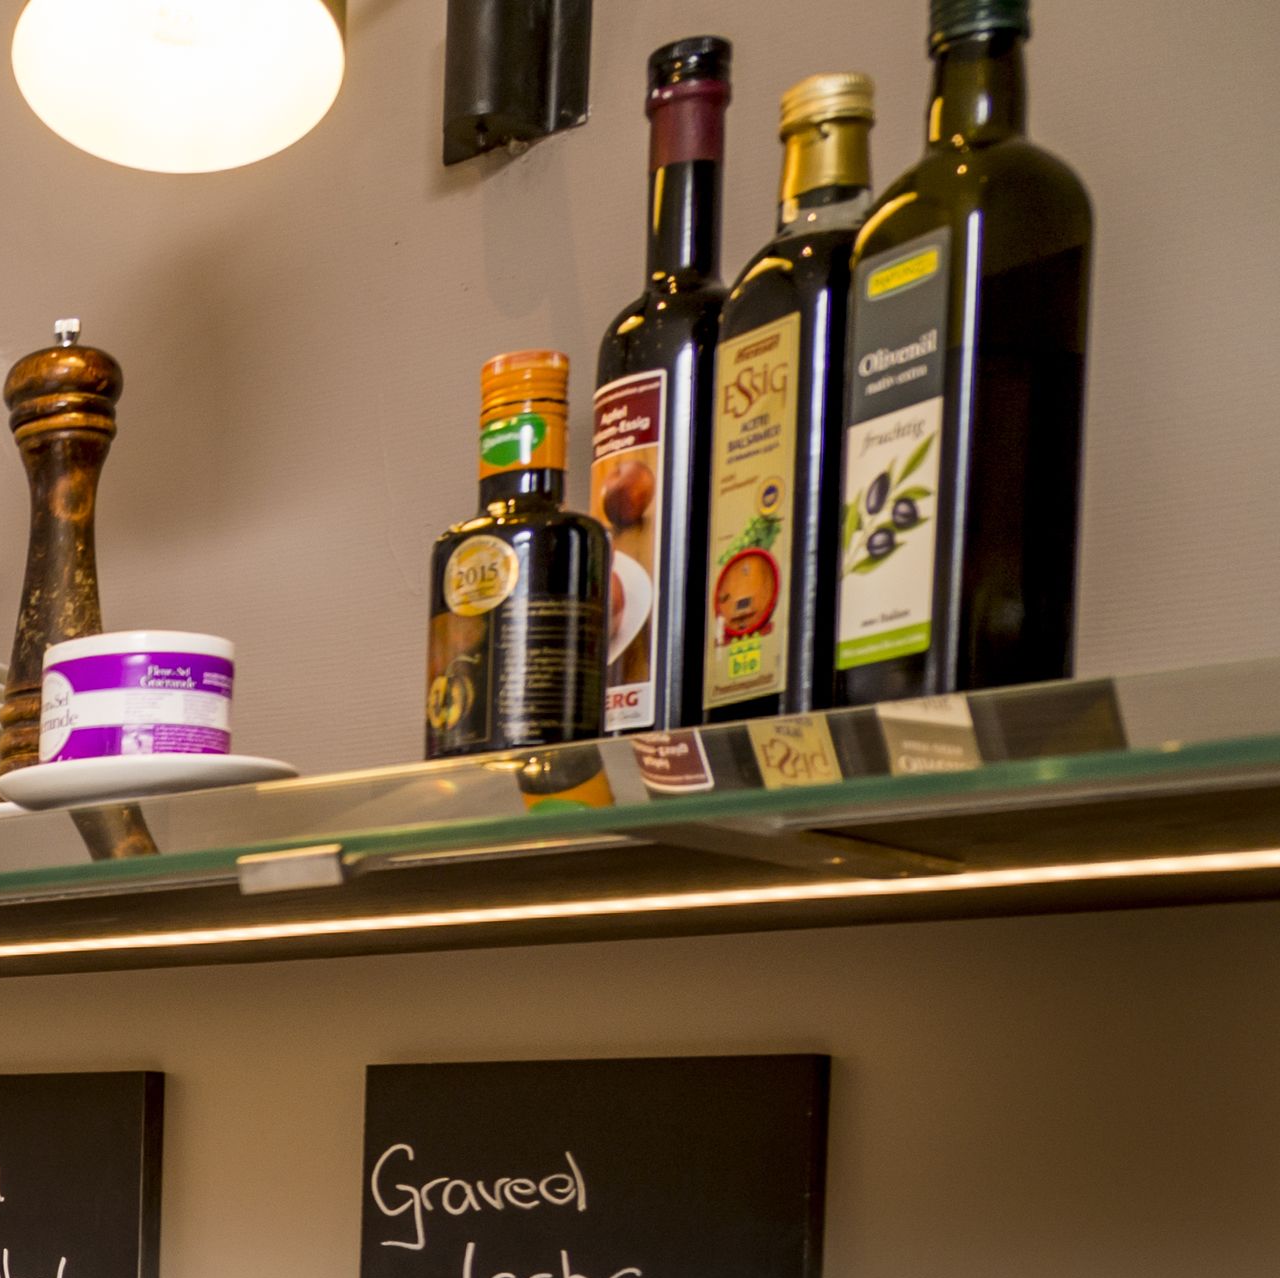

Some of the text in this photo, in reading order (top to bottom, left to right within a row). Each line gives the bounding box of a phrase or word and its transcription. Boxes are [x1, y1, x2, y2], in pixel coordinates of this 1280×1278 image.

[456, 562, 498, 590] 2015
[606, 691, 638, 711] ERG
[372, 1144, 587, 1249] Graved
